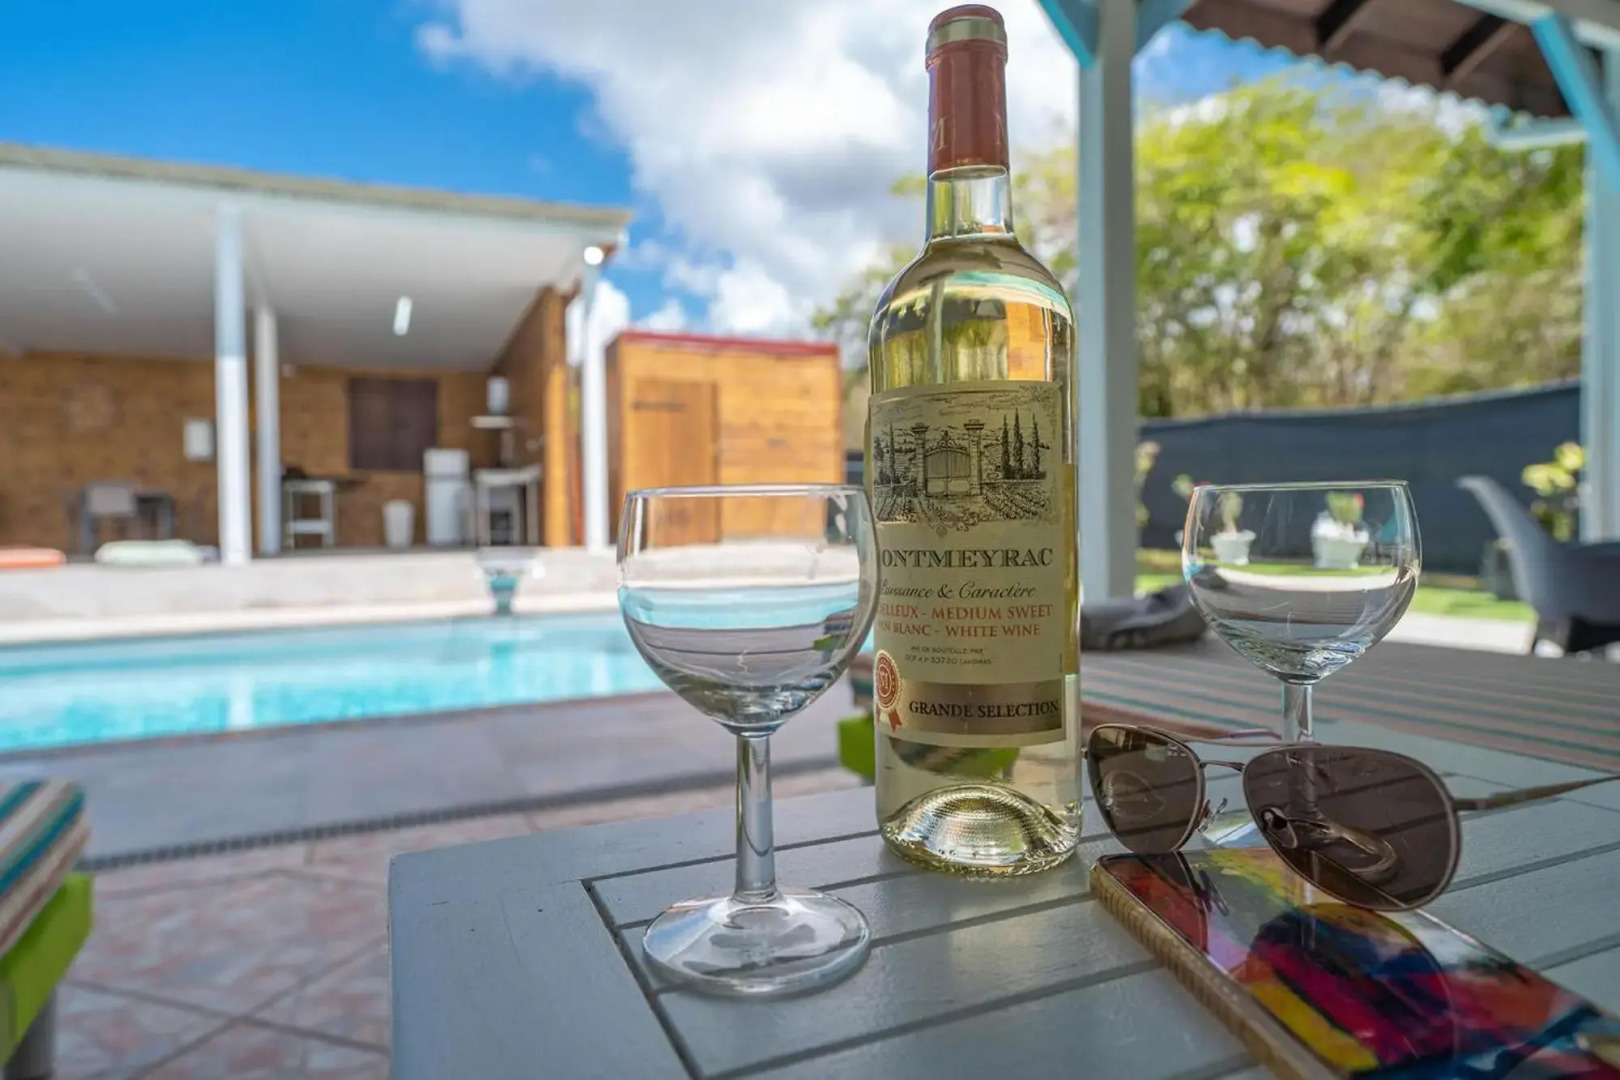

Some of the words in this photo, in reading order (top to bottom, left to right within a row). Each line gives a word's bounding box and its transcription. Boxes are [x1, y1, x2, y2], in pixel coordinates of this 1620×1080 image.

[881, 548, 1053, 568] ONTMEYRAC
[880, 579, 933, 599] uissance
[937, 583, 953, 599] &
[959, 580, 1036, 599] Caractère
[879, 603, 918, 619] ELLEUX
[931, 606, 1002, 620] MEDIUM
[1007, 604, 1053, 619] SWEET
[893, 622, 931, 636] BLANC
[945, 625, 998, 637] WHITE
[1002, 624, 1040, 636] WINE
[909, 700, 973, 718] GRANDE
[977, 700, 1059, 718] SELECTION
